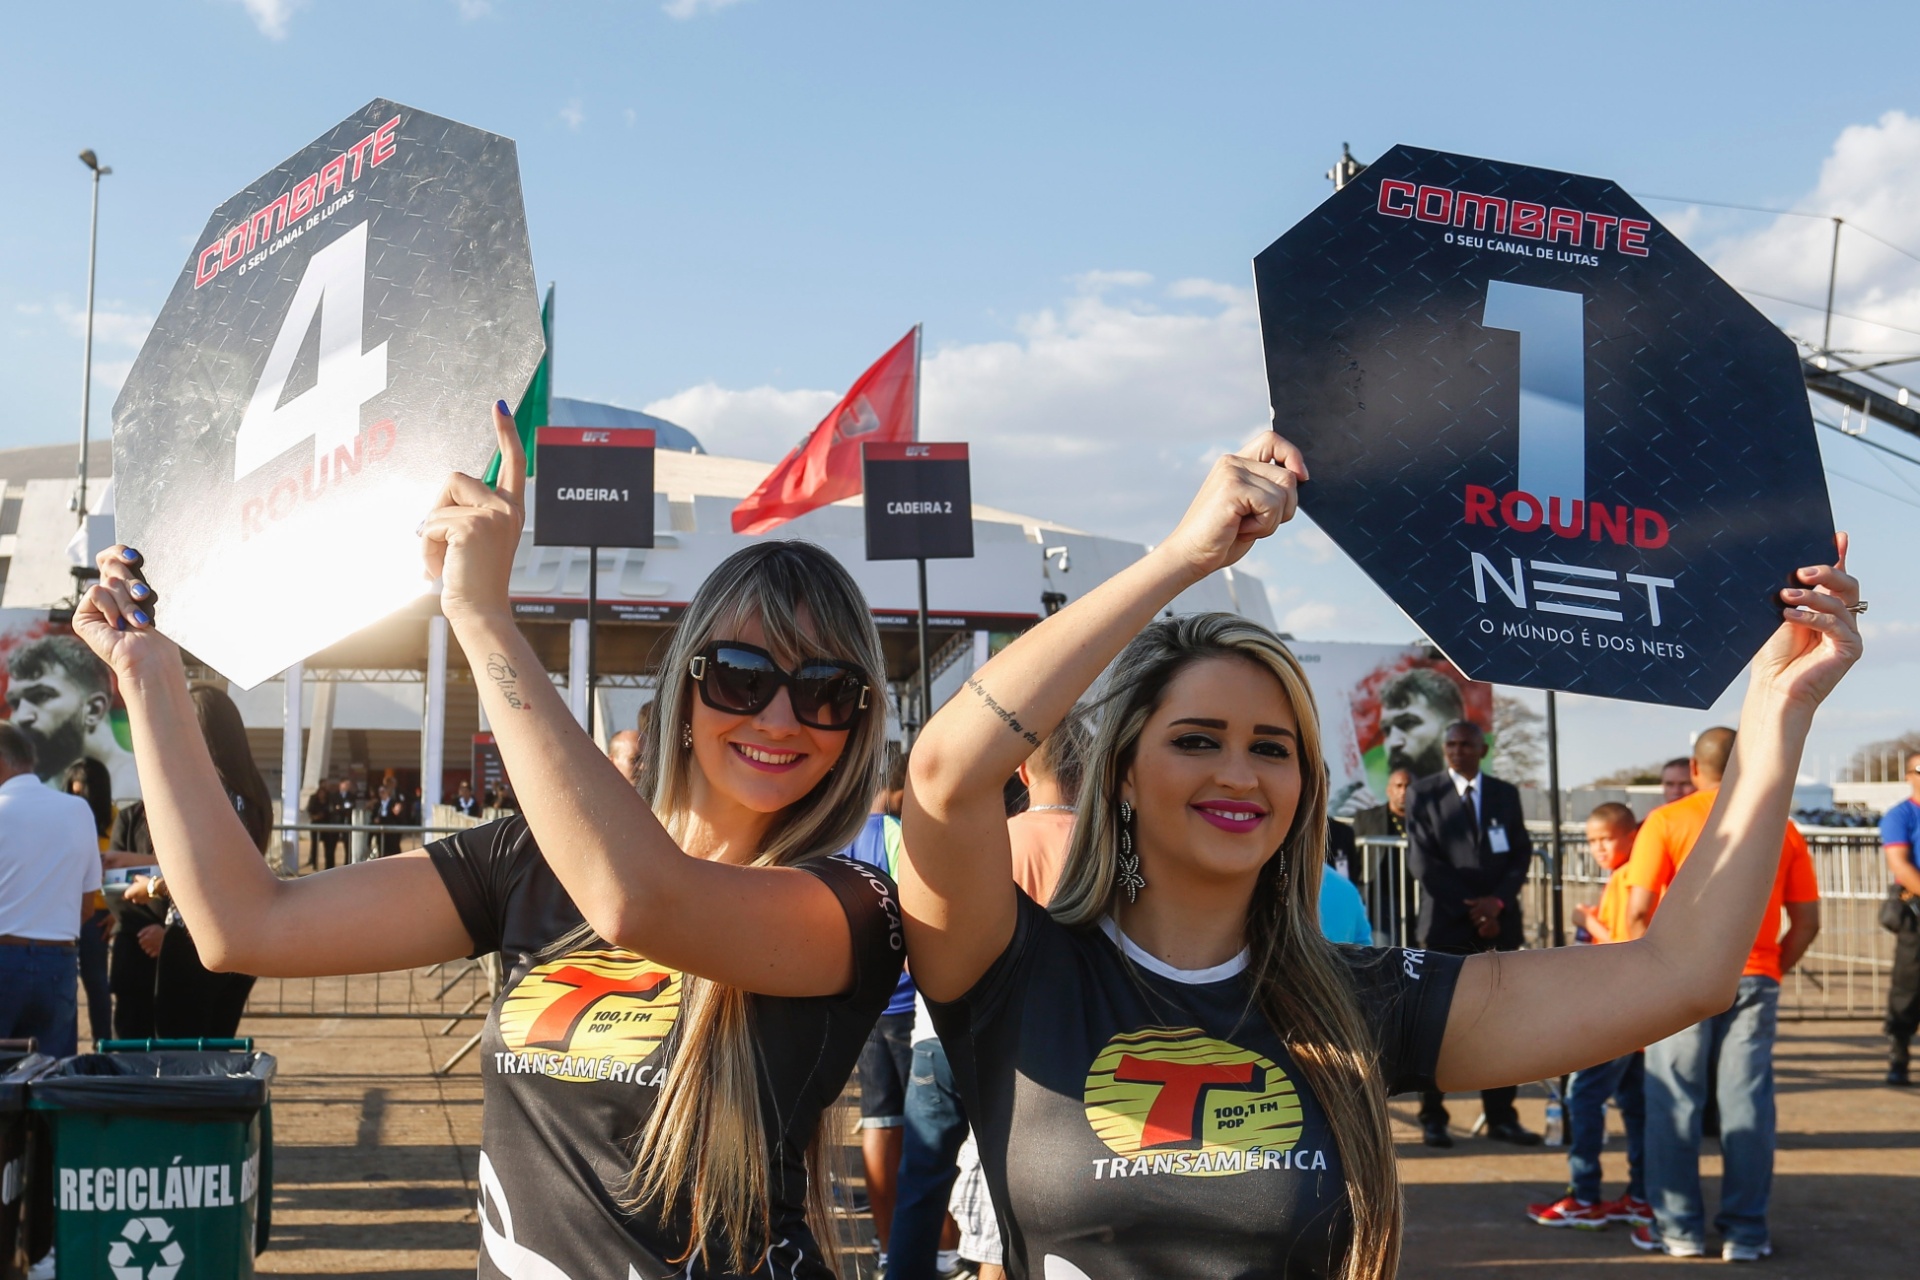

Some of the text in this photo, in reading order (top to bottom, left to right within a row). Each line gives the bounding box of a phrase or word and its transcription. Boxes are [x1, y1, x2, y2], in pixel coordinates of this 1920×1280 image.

[194, 114, 401, 290] COMBATE
[1377, 178, 1650, 257] COMBATE
[238, 190, 355, 276] O SEU CANAL DE LUTAS
[1444, 233, 1599, 267] O SEU CANAL DE LUTAS
[234, 220, 388, 487] 4
[1482, 279, 1585, 529] 1
[581, 431, 610, 443] UFC
[905, 446, 931, 457] UFC
[242, 418, 397, 542] ROUND
[557, 487, 629, 502] CADEIRA 1
[887, 501, 952, 514] CADEIRA 2
[1464, 484, 1670, 549] ROUND
[1471, 551, 1675, 627] NET
[1480, 619, 1685, 659] O MUNDO É DOS NETS
[588, 1023, 613, 1033] POP
[592, 1011, 652, 1024] 100,1 FM
[495, 1051, 668, 1088] TRANSAMÉRICA
[1214, 1101, 1278, 1119] 100,1 FM
[1217, 1118, 1244, 1130] POP
[1092, 1146, 1327, 1180] TRANSAMÉRICA
[60, 1155, 234, 1211] RECICLÁVEL
